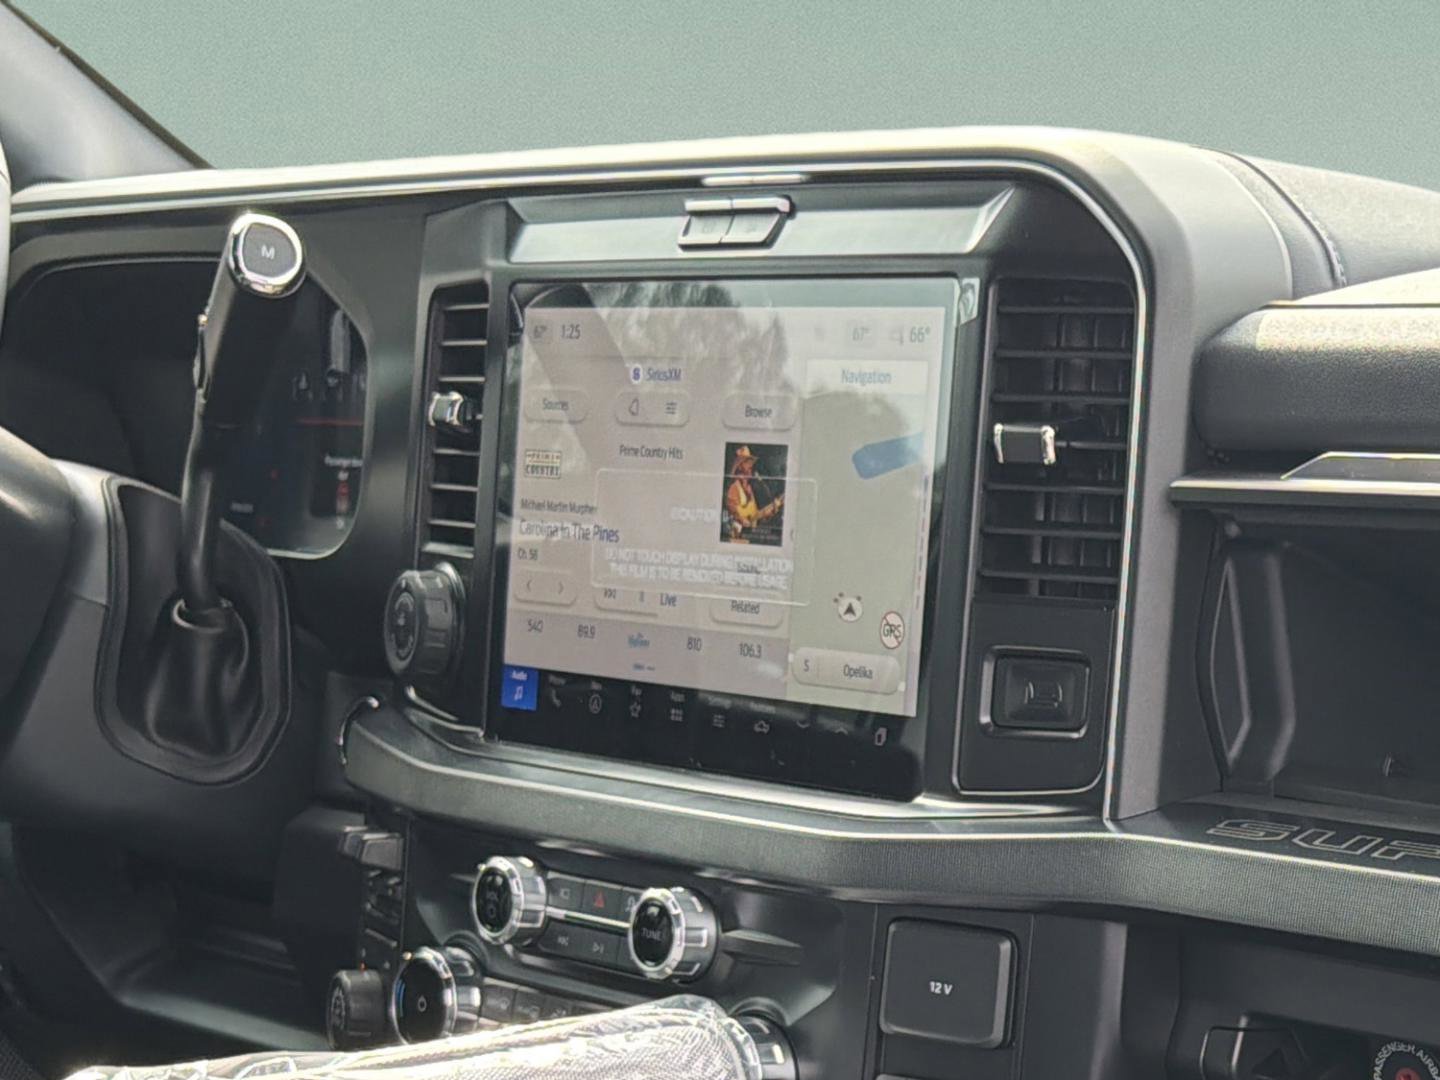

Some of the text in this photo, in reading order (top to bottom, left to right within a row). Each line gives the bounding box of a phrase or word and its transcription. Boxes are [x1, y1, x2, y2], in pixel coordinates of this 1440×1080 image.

[261, 245, 275, 260] M
[561, 324, 581, 340] 1:25
[909, 326, 931, 343] 66°
[646, 367, 682, 383] SiriusXM
[841, 368, 892, 386] Navigation
[744, 404, 773, 419] Browse
[619, 444, 684, 460] Prime Country Hits
[571, 522, 591, 540] The
[592, 524, 620, 543] Pines
[660, 593, 677, 608] Live
[730, 600, 760, 615] Related
[577, 624, 596, 640] 89.9
[687, 636, 702, 651] 810
[739, 643, 762, 659] 106.3
[843, 663, 873, 680] Opelika
[641, 927, 666, 942] TUNE
[929, 981, 953, 996] 12 V
